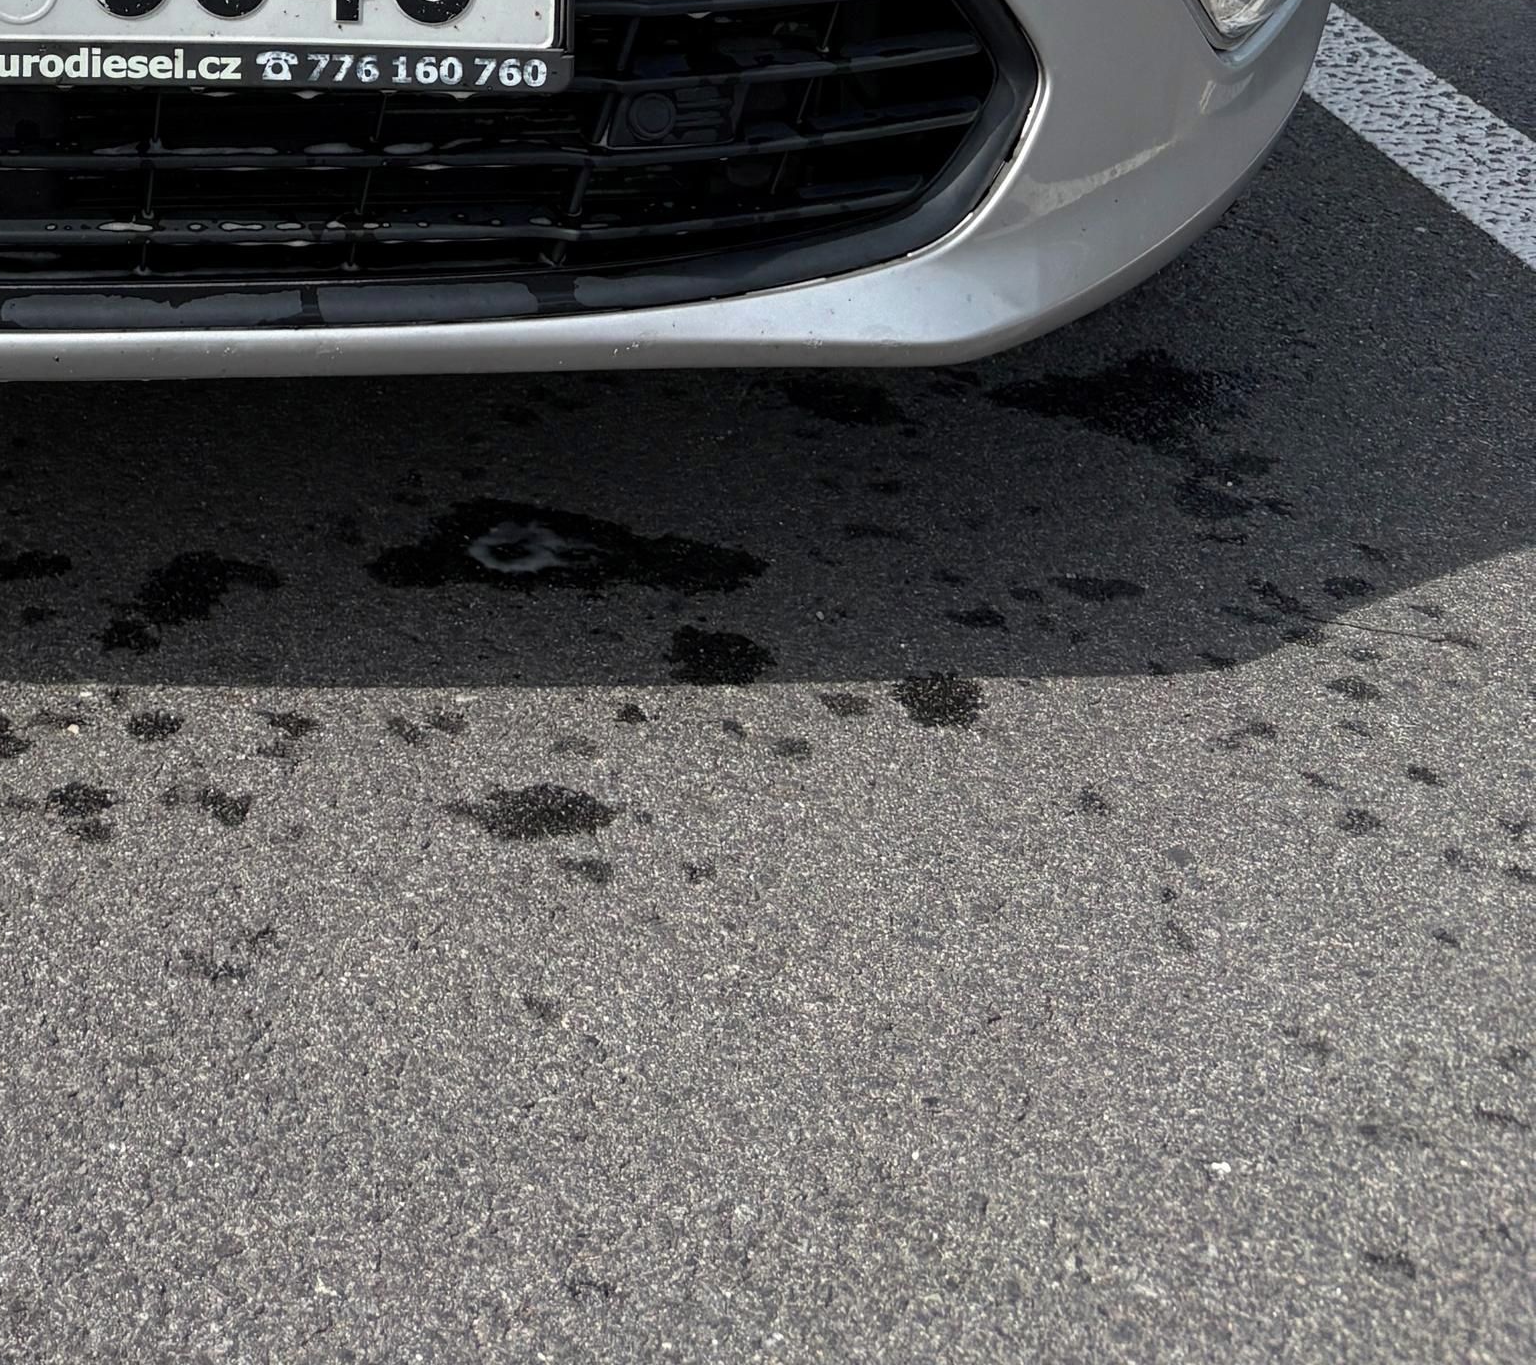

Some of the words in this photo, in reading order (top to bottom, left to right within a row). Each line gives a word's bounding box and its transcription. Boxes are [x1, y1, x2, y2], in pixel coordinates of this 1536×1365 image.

[307, 53, 380, 83] 776
[391, 55, 464, 85] 160
[474, 57, 548, 87] 760
